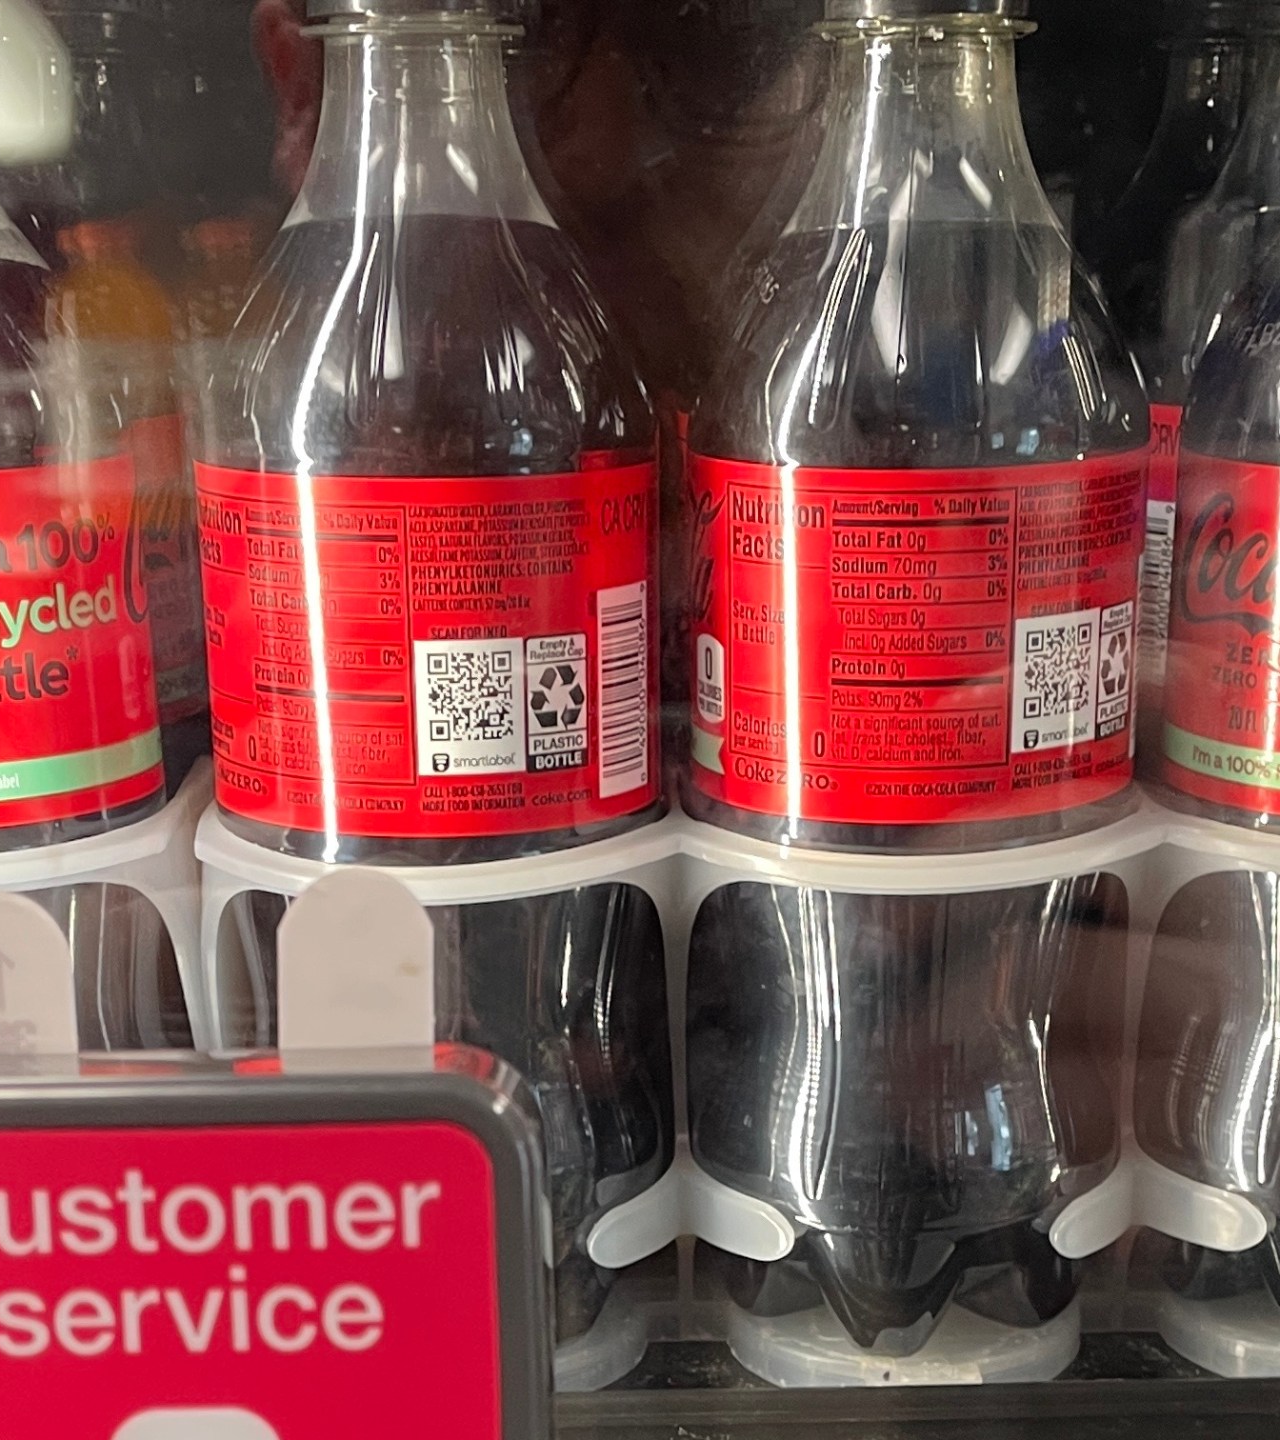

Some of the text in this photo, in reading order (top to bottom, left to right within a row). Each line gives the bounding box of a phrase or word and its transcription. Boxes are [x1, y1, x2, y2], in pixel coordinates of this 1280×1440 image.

[601, 498, 620, 535] CA
[832, 499, 977, 516] Amount/Serving % Daily
[16, 512, 115, 571] 100%
[733, 526, 784, 560] Facts
[832, 529, 1008, 551] Total Fat 0g 0%
[248, 538, 400, 564] Total 0%
[832, 555, 1007, 576] Sodium 70mg 3%
[380, 573, 401, 589] 3%
[412, 579, 502, 596] PHENYLALANINE
[832, 580, 1007, 602] Total Carb. 0g 0%
[250, 589, 401, 615] Total 0%
[838, 608, 925, 629] Total Sugars 0g
[871, 631, 1005, 654] 0g Added Sugars 0%
[383, 649, 404, 665] 0%
[255, 663, 295, 684] Protein
[831, 658, 906, 679] Protein 0g
[868, 690, 923, 711] 90mg 2%
[734, 711, 787, 738] Calories
[864, 716, 923, 732] significant
[926, 716, 964, 730] source
[533, 734, 583, 751] PLASTIC
[814, 731, 825, 758] 0
[535, 751, 582, 769] BOTTLE
[913, 749, 935, 762] and
[1191, 745, 1211, 767] I'm
[1213, 754, 1223, 770] a
[734, 757, 774, 783] Coke
